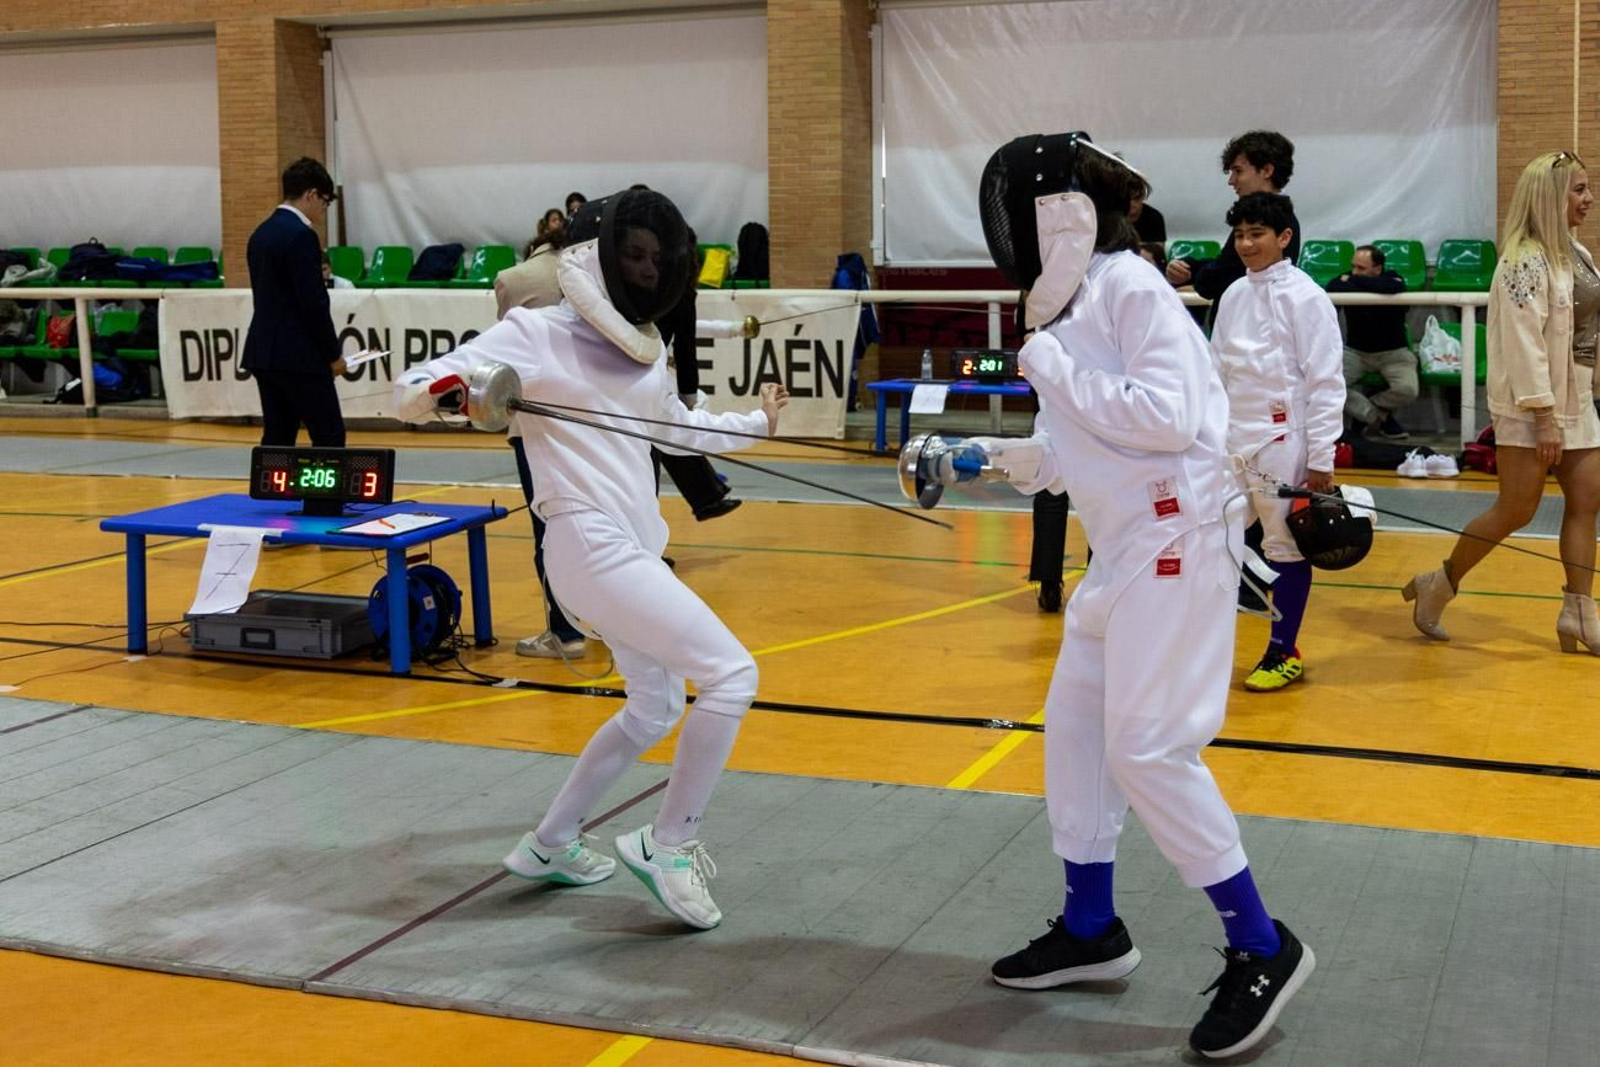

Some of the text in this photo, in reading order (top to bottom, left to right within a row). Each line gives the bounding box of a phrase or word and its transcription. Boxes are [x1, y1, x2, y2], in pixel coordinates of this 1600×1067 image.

[728, 323, 844, 398] JAÉN
[273, 468, 378, 497] 4 2:06 3
